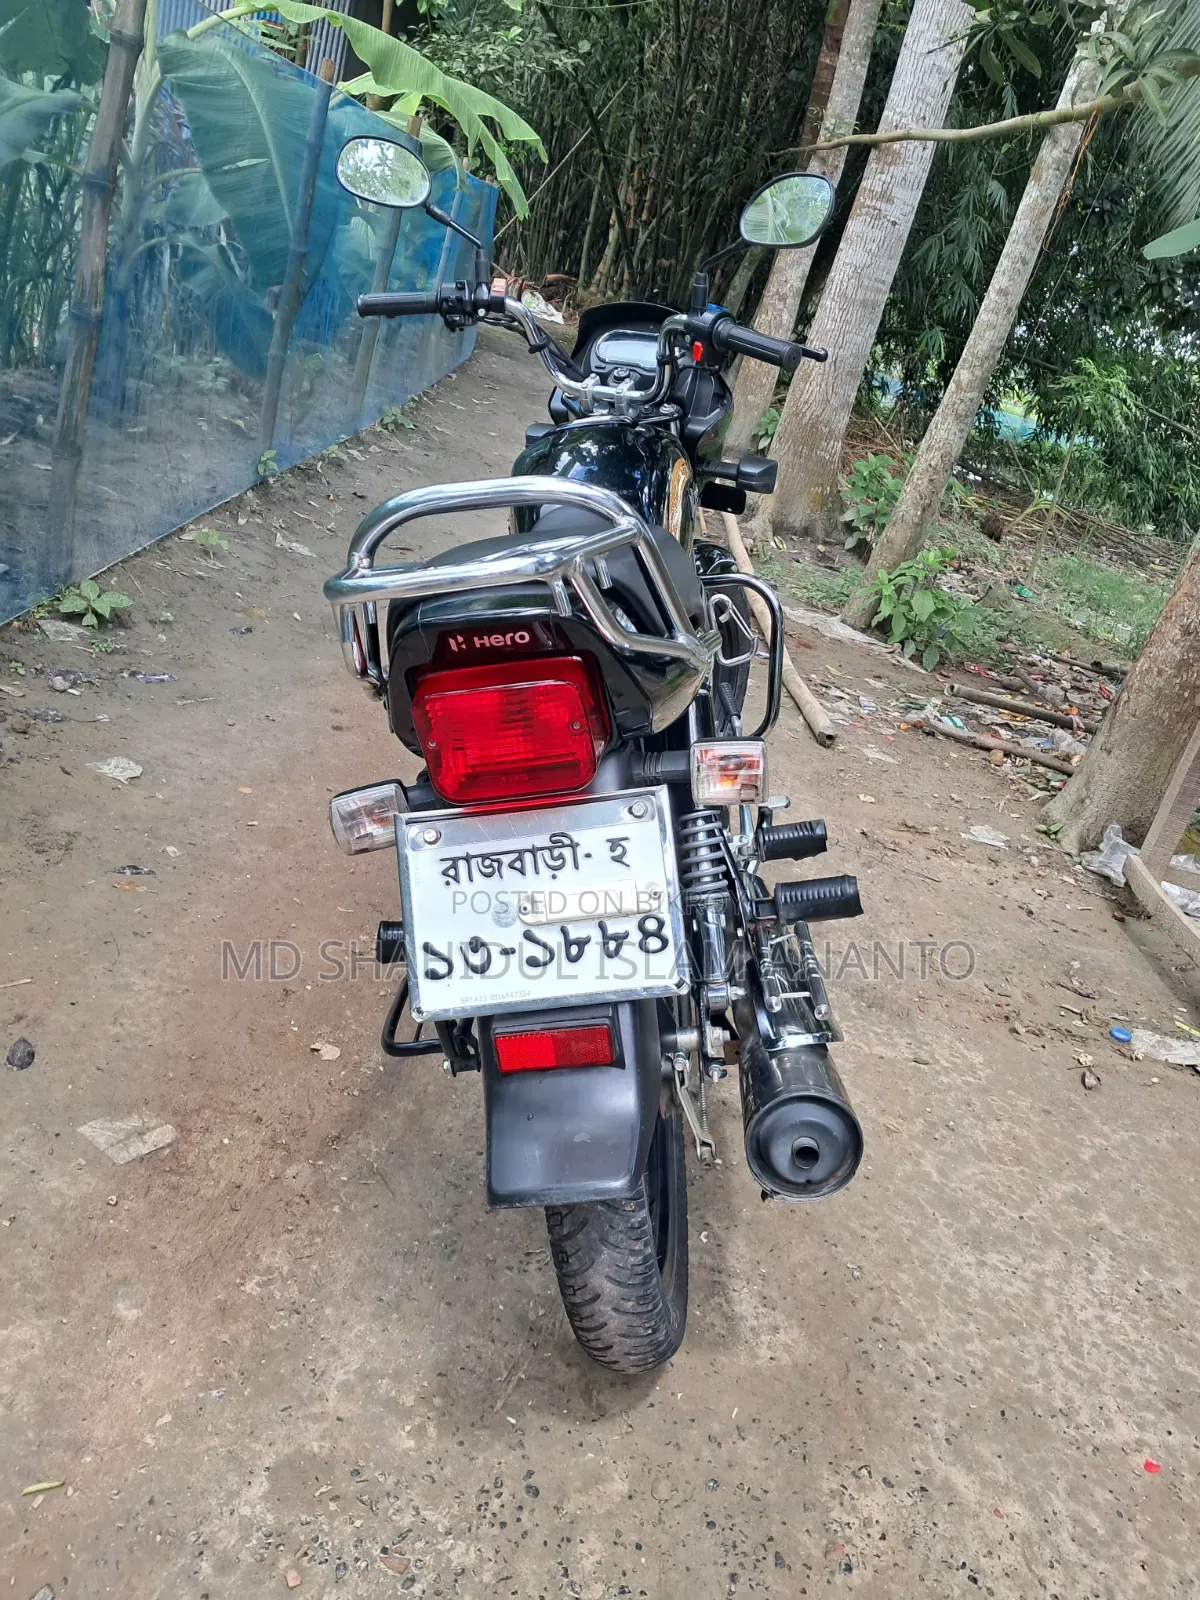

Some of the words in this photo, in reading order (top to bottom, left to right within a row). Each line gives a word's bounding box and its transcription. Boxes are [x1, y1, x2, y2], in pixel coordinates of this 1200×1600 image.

[474, 631, 531, 648] Hero
[606, 836, 631, 868] হ
[422, 914, 670, 981] ১৩-১৮৮৪
